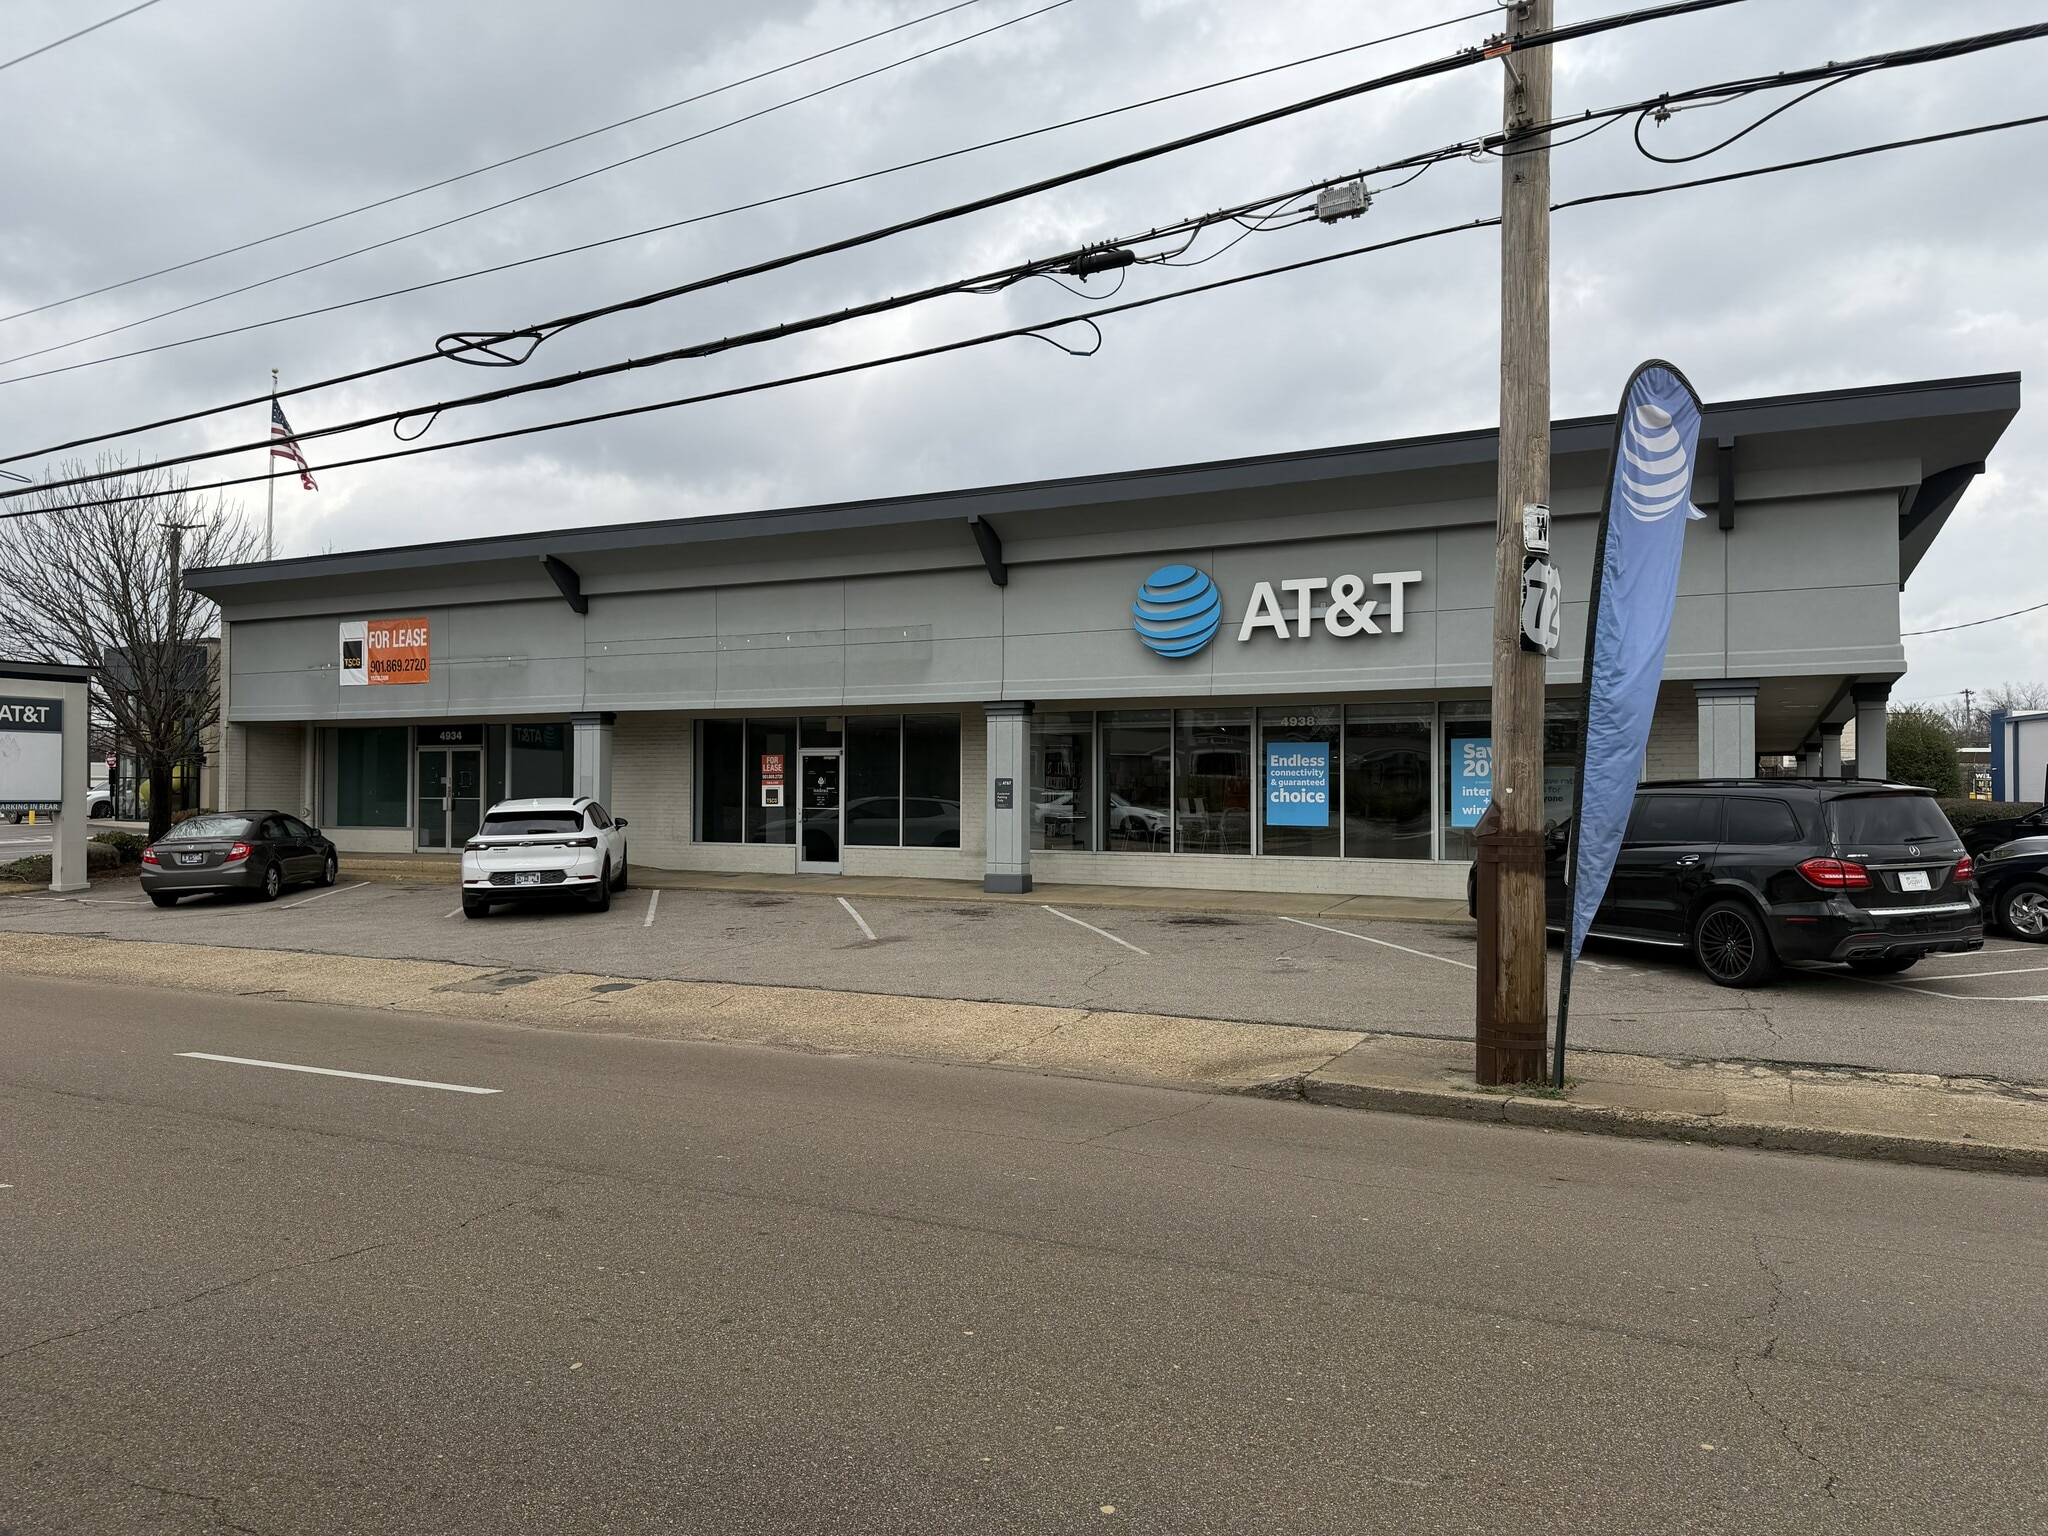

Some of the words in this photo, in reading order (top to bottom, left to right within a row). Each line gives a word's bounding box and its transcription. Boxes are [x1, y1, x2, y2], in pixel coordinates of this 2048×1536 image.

[1237, 570, 1422, 642] AT&T
[1529, 578, 1559, 636] 72
[368, 630, 390, 649] FOR
[392, 627, 427, 648] LEASE
[344, 658, 361, 667] TSCG
[370, 658, 426, 673] 901.869.2720
[0, 704, 50, 723] AT&T
[1280, 716, 1316, 727] 4938
[439, 731, 463, 740] 4934
[1463, 743, 1492, 759] Sav
[1270, 754, 1326, 767] Endless
[762, 764, 783, 772] LEASE
[1270, 768, 1325, 779] connectivity
[1462, 759, 1492, 777] 20
[1278, 778, 1326, 788] guaranteed
[1270, 788, 1326, 803] choice
[1462, 786, 1492, 797] inter
[1544, 795, 1564, 804] yone
[0, 803, 29, 811] ARKING
[29, 803, 38, 811] IN
[39, 803, 58, 811] REAR
[1462, 804, 1488, 815] wire
